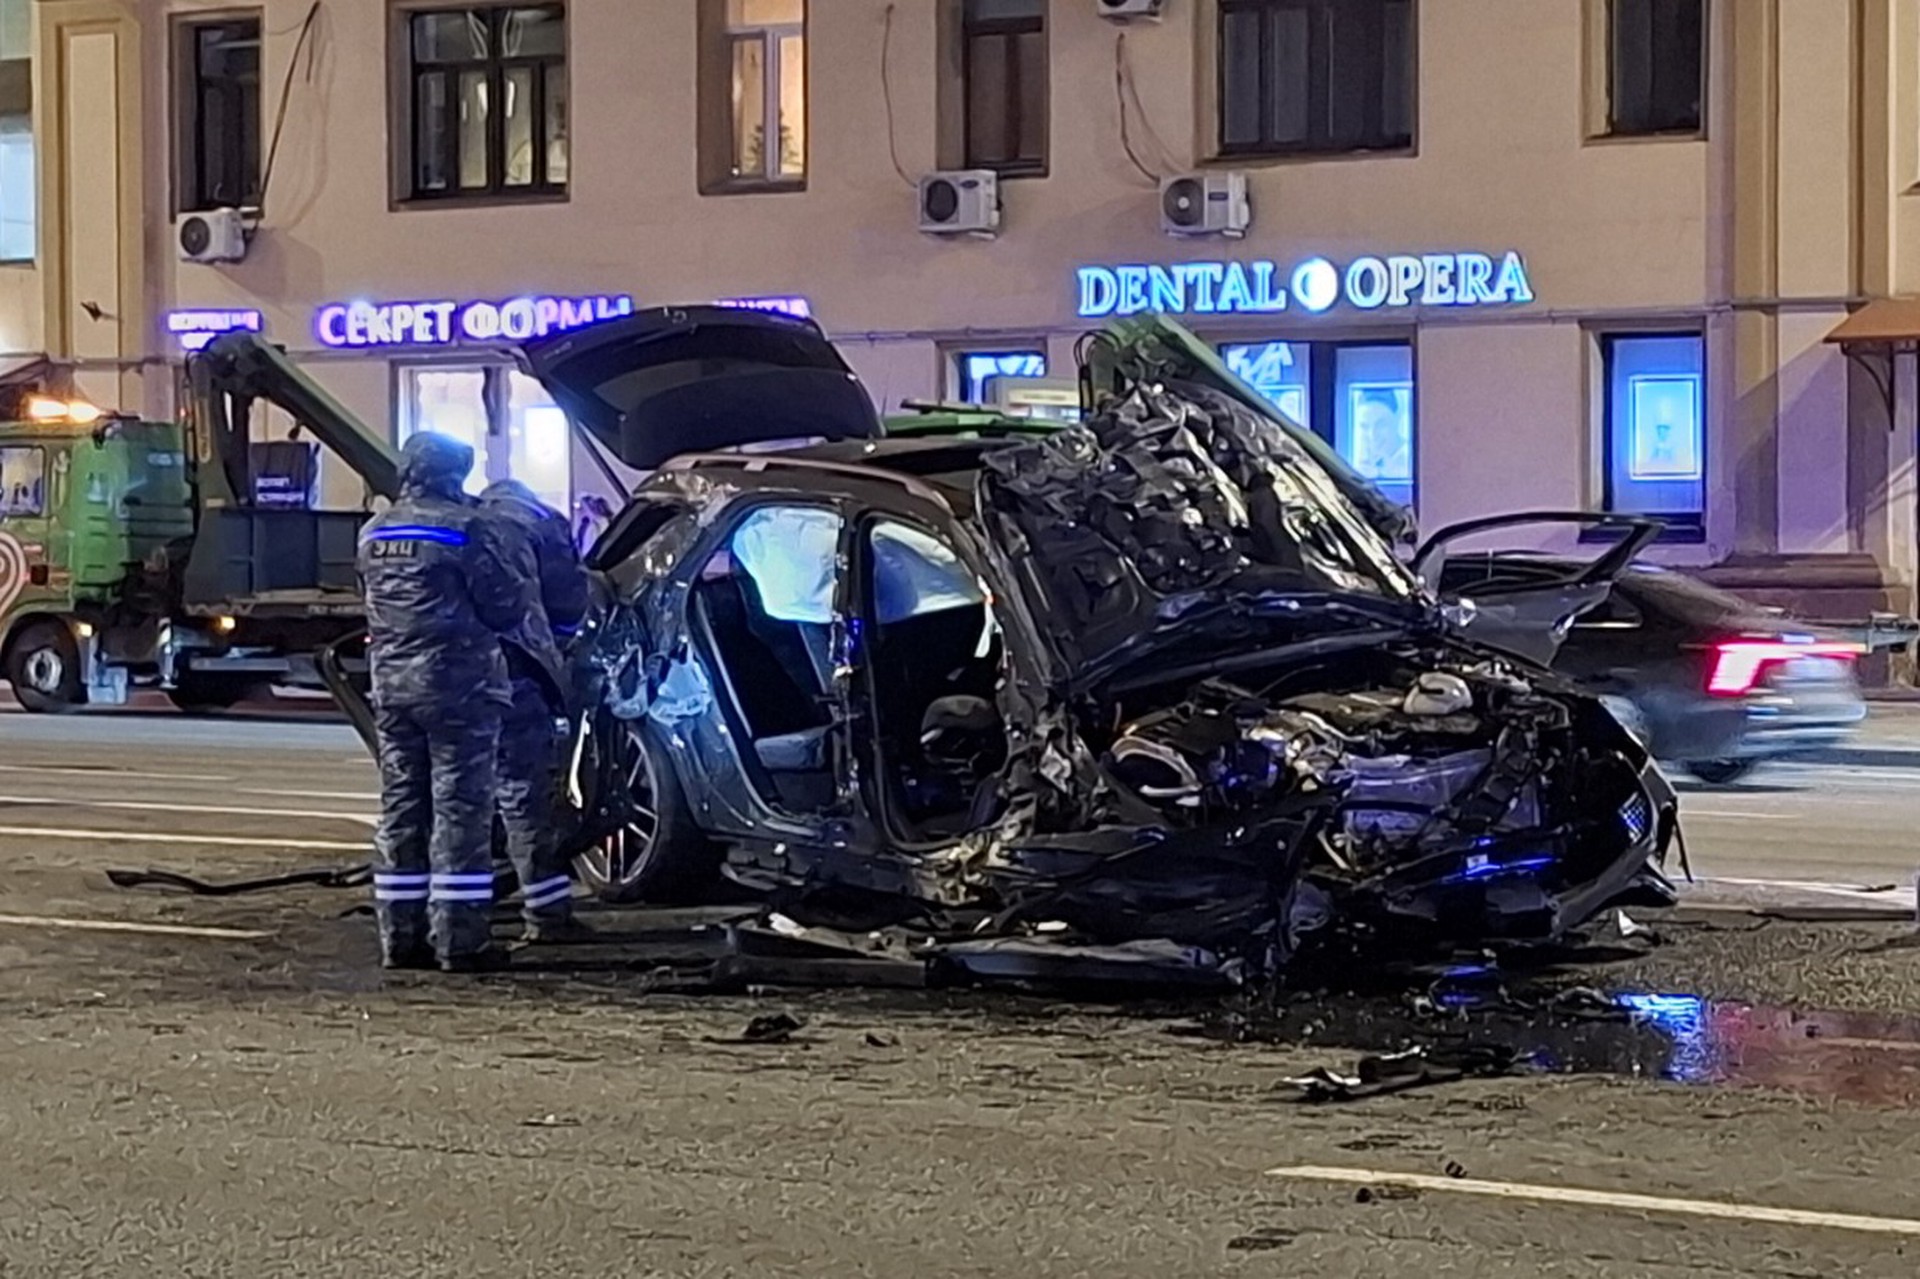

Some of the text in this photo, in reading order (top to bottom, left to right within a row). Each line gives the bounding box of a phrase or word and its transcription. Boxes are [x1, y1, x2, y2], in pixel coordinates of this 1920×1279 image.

[1078, 252, 1534, 316] DENTAL OPERA
[317, 301, 456, 345] СЕКРЕТ
